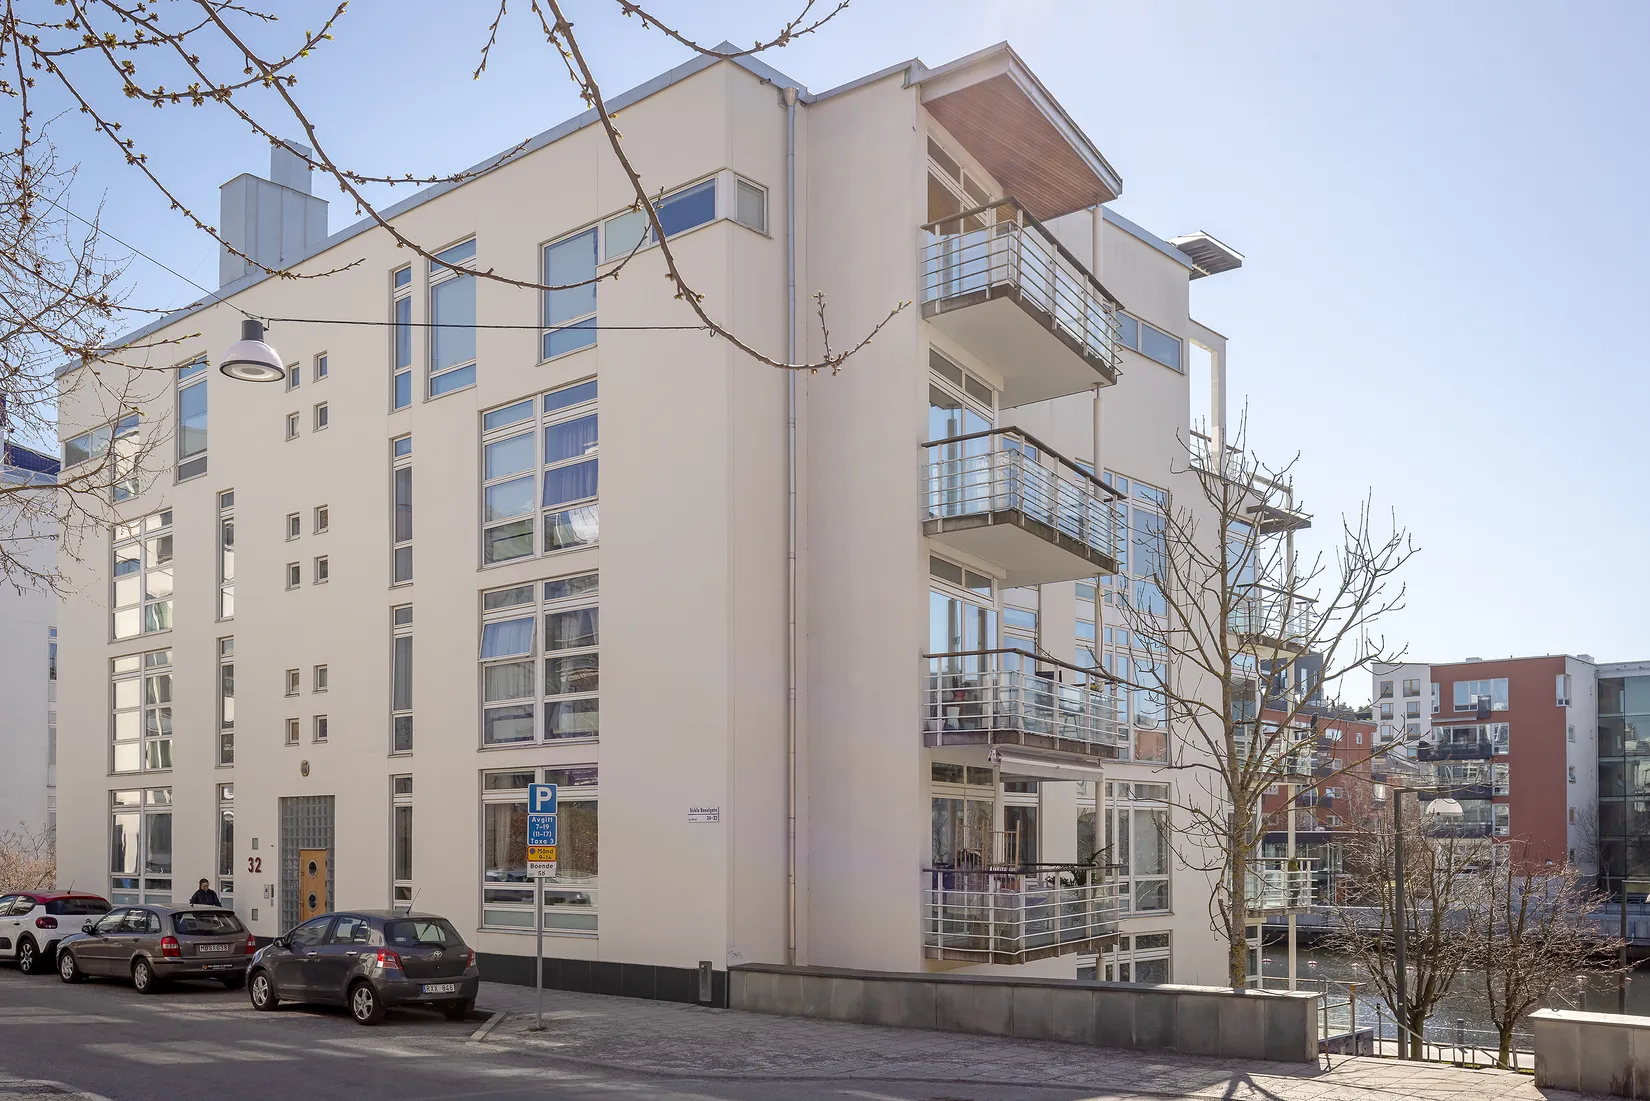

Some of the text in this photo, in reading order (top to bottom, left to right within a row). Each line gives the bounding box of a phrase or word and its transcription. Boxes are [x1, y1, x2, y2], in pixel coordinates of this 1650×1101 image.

[536, 787, 552, 810] P
[531, 816, 553, 824] Avgift
[532, 830, 552, 838] (11-17)
[247, 856, 263, 873] 32
[425, 984, 454, 992] RXX 846
